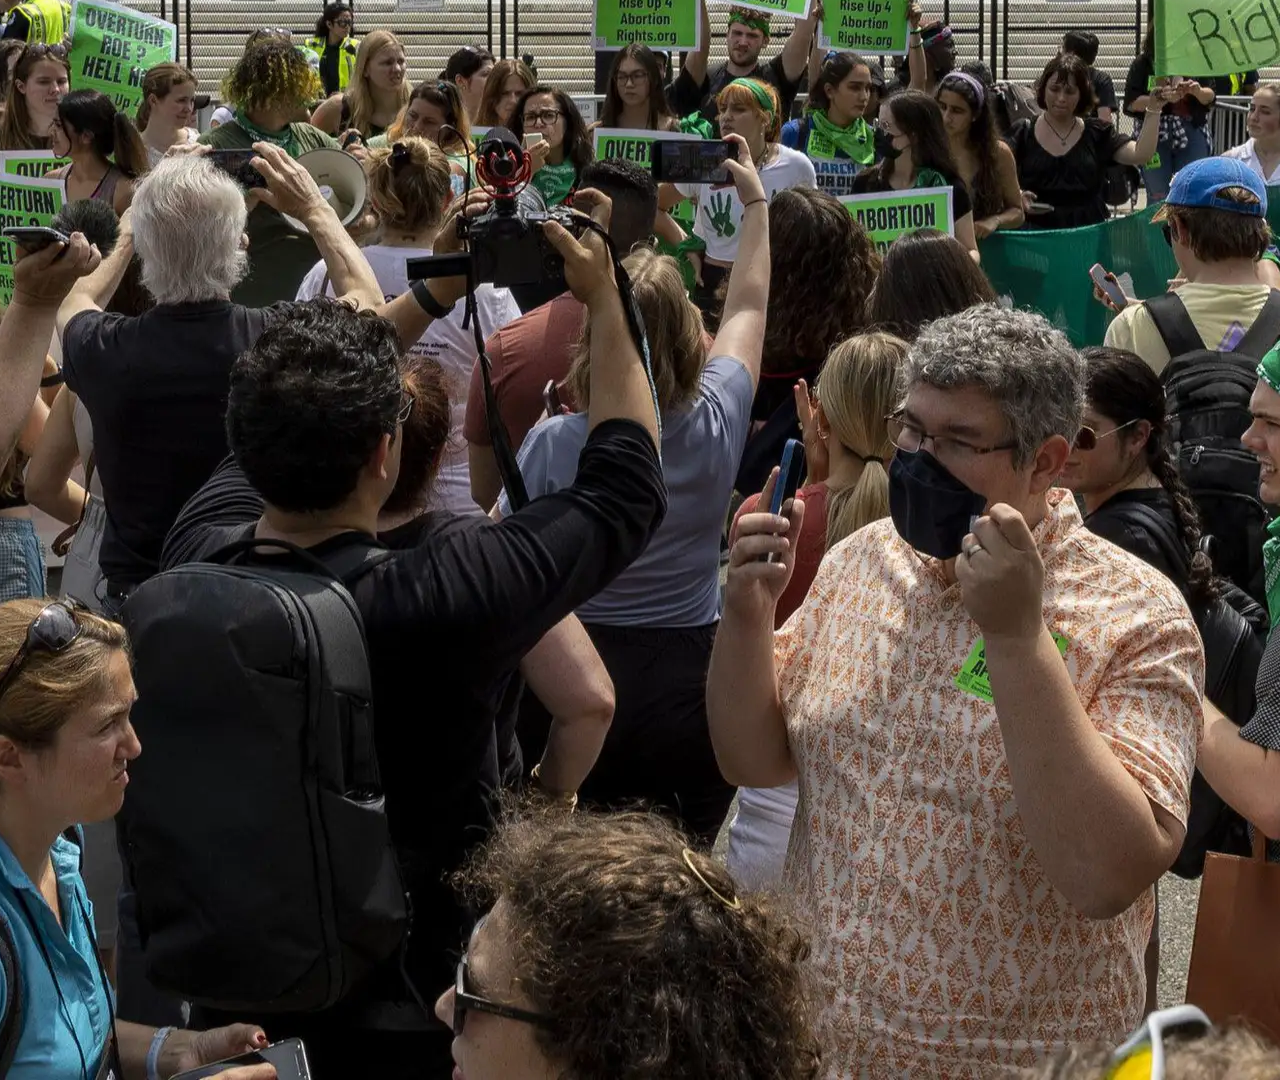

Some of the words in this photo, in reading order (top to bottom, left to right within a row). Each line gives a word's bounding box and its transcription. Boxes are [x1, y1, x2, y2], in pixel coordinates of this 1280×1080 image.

[867, 0, 882, 16] Up
[884, 1, 892, 13] 4
[620, 13, 670, 24] Abortion
[840, 16, 888, 29] Abortion
[85, 8, 164, 47] OVERTURN
[617, 29, 677, 44] Rights.org
[838, 32, 892, 49] Rights.org
[101, 35, 131, 60] ROE
[82, 55, 122, 83] HELL
[115, 93, 130, 110] Up
[856, 203, 935, 231] ABORTION
